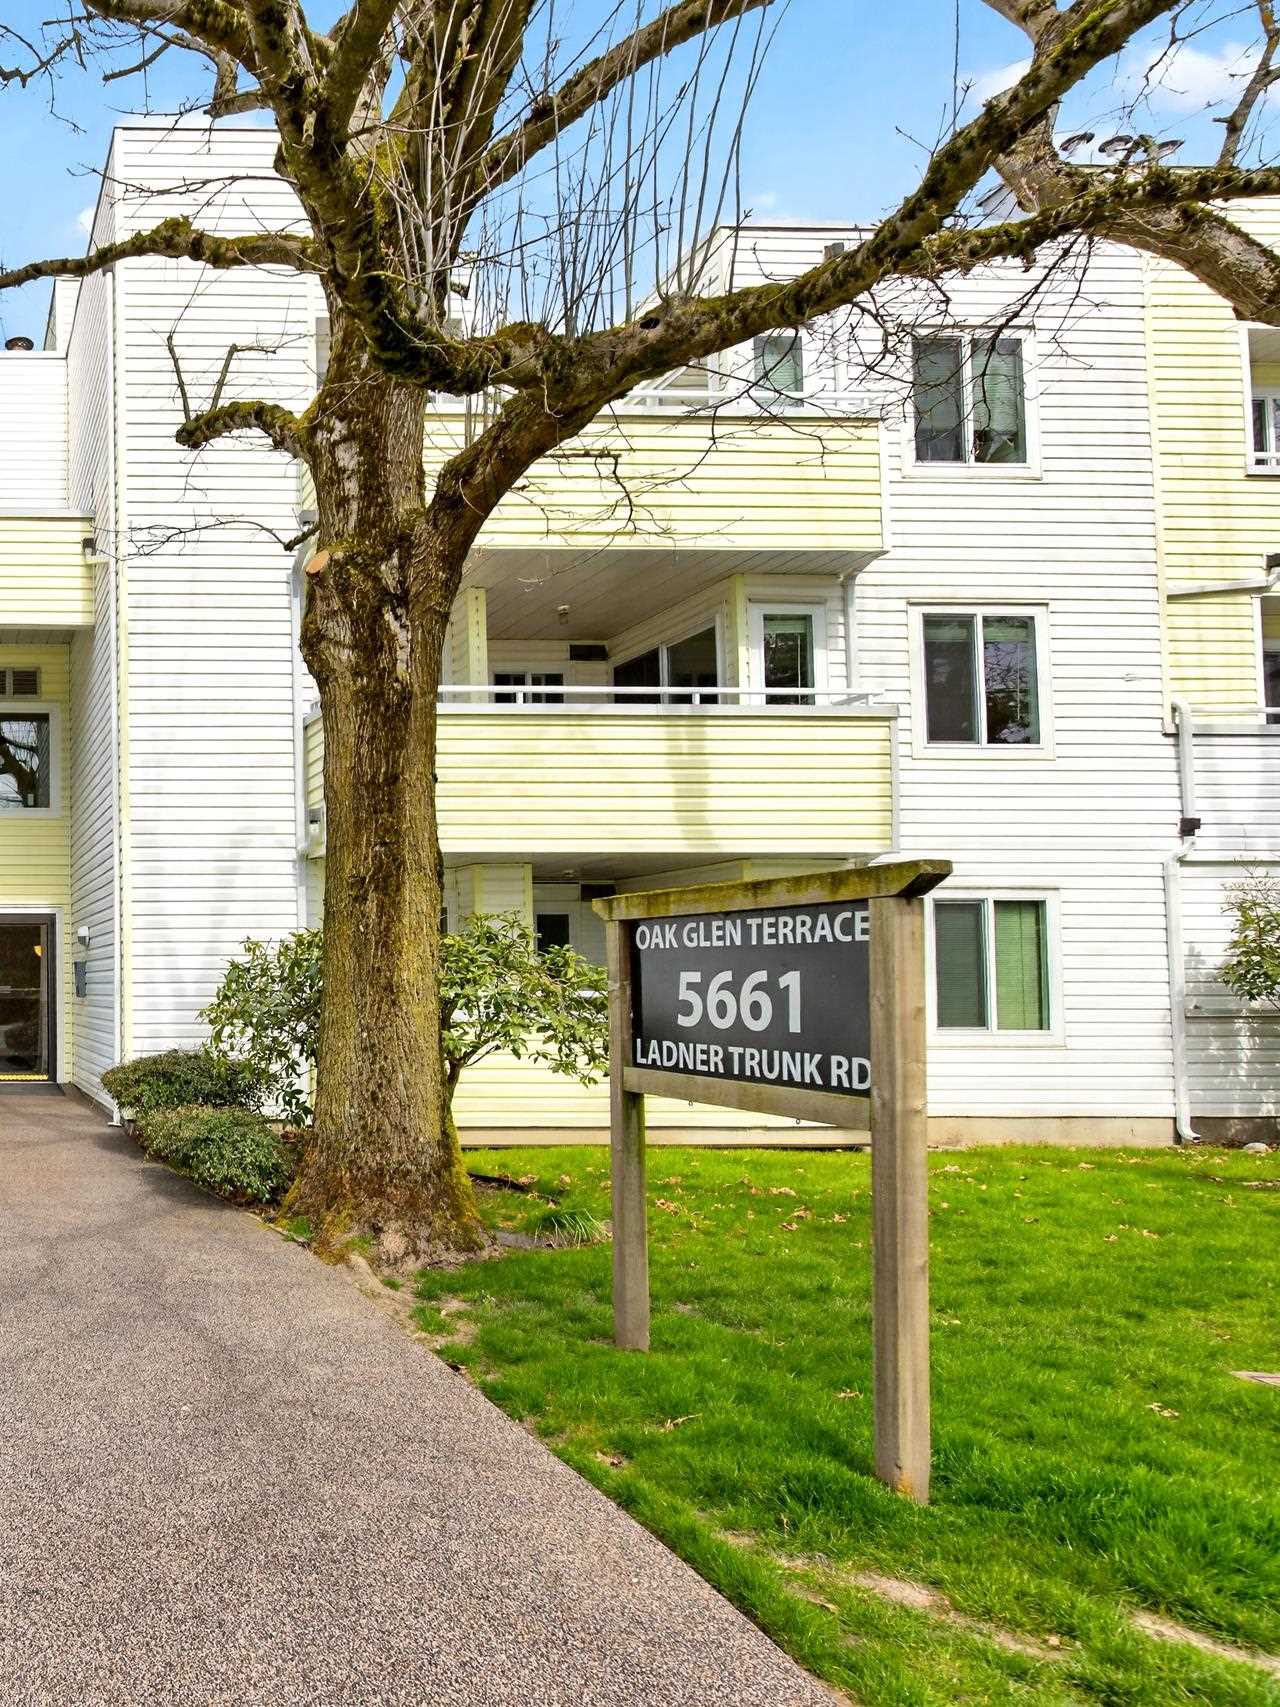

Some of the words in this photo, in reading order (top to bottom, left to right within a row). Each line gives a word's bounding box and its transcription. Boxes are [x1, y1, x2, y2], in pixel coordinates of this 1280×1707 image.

[636, 923, 678, 950] OAK
[682, 919, 742, 948] GLEN
[746, 910, 870, 945] TERRACE
[677, 970, 801, 1033] 5661
[636, 1038, 725, 1072] LADNER
[728, 1046, 823, 1085] TRUNK
[830, 1055, 871, 1090] RD
